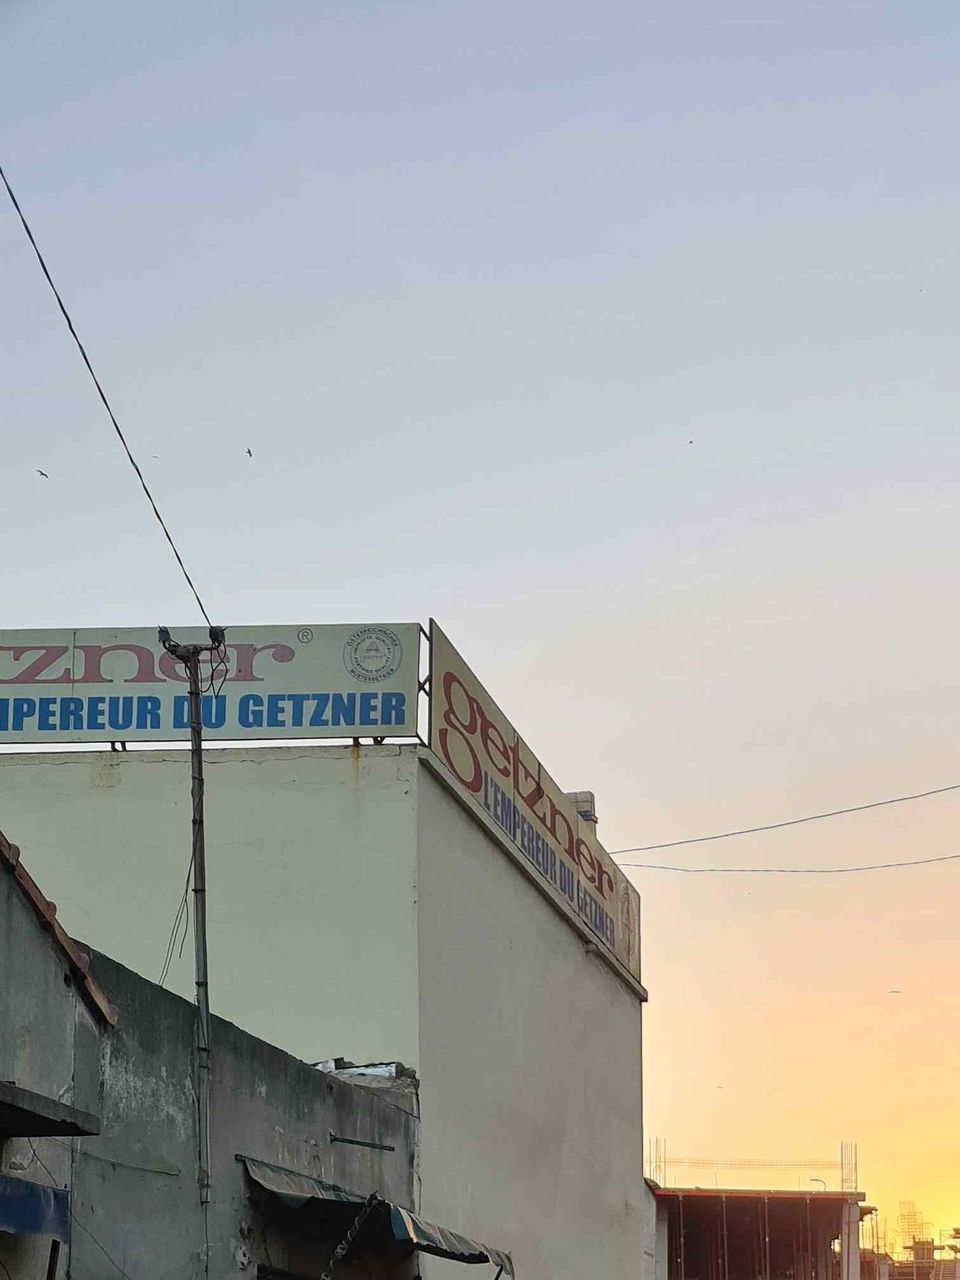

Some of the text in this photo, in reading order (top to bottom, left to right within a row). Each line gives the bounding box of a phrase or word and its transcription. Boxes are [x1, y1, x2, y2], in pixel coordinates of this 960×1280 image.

[173, 694, 227, 729] DU
[238, 692, 406, 728] GETZNER
[438, 671, 614, 900] getzner
[484, 769, 615, 949] L'EMPEREUR DU GETZNER
